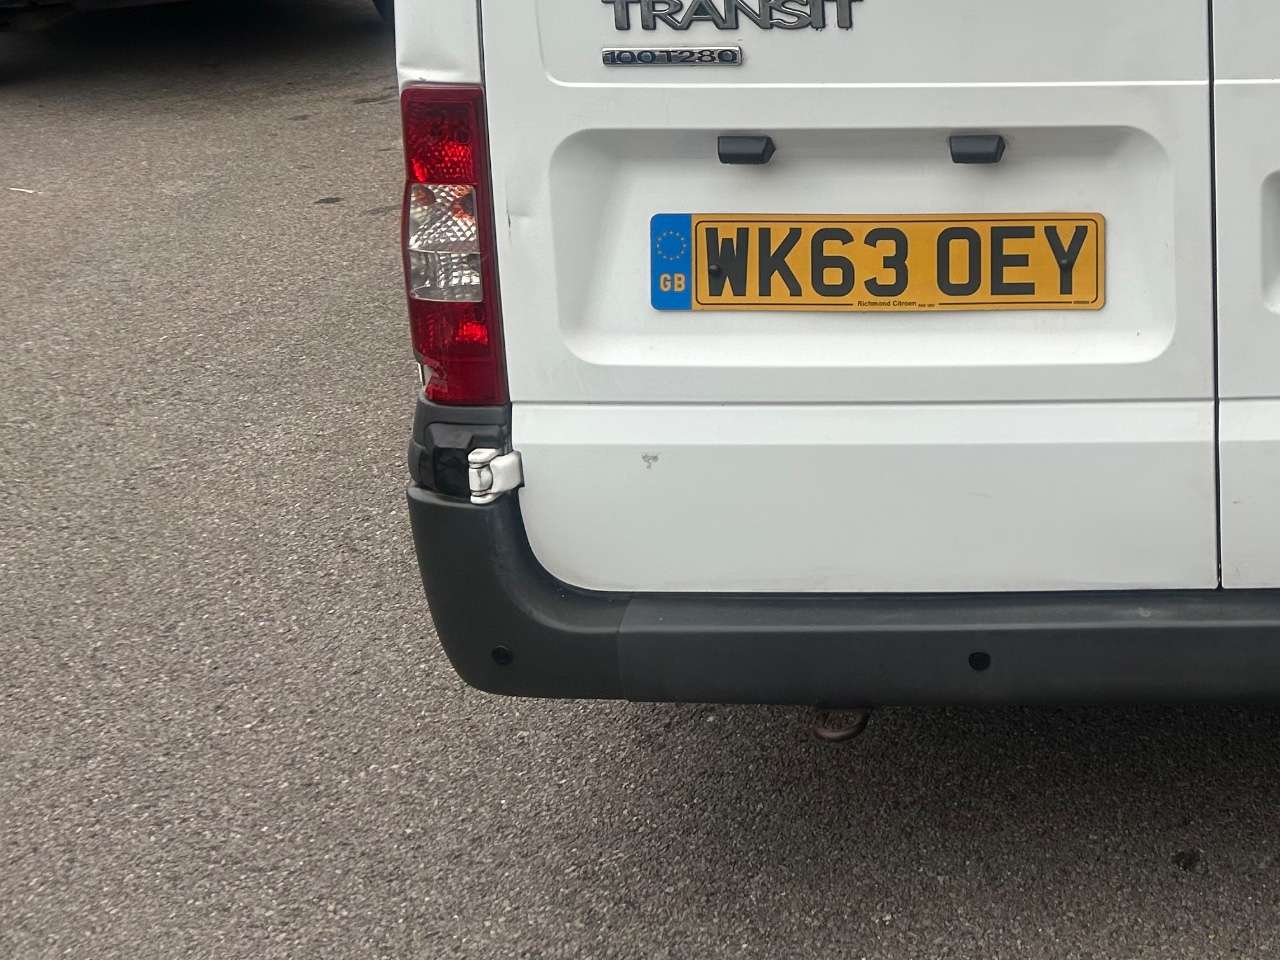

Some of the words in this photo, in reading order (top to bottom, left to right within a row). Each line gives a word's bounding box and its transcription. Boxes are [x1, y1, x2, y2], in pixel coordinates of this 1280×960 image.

[658, 272, 686, 293] GB
[704, 226, 909, 298] WK63
[936, 224, 1089, 297] OEY
